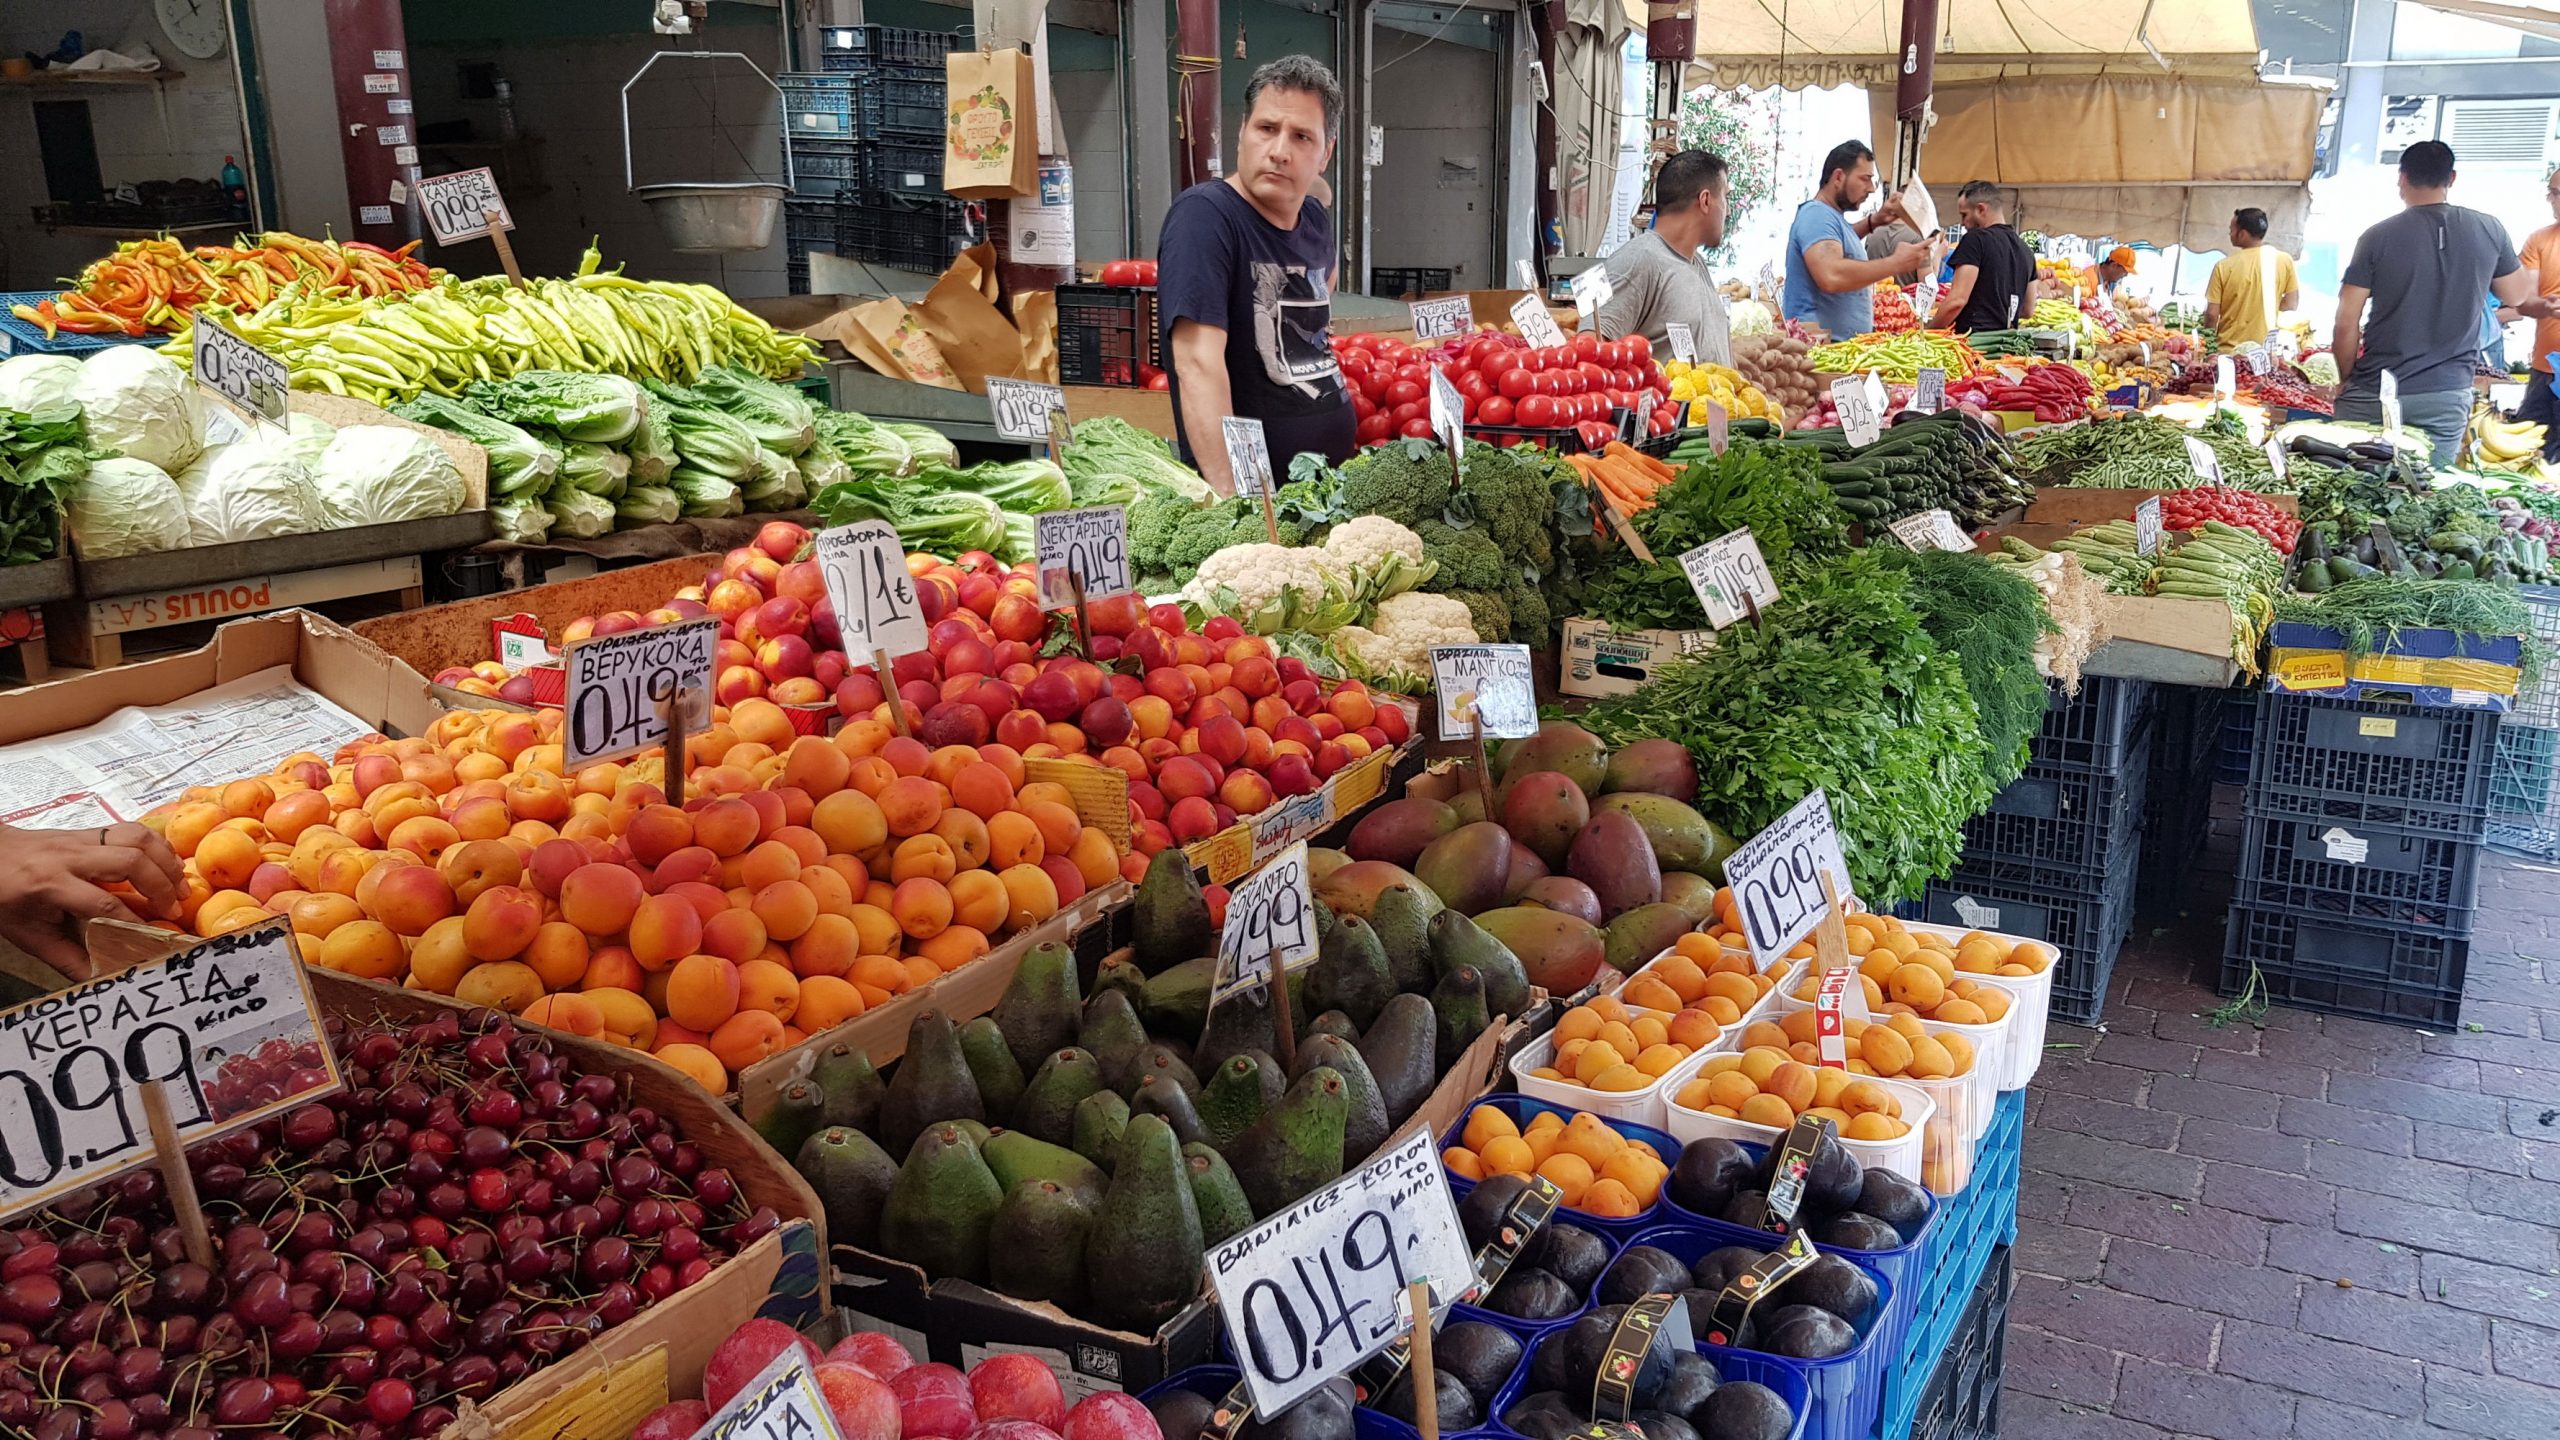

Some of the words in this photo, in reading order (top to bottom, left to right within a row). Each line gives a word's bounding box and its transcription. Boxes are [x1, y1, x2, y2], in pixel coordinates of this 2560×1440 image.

[424, 178, 491, 202] ΚΑΥΤΕΡΕΣ
[1414, 301, 1467, 317] ΦΛΩΡΙΝΗΣ
[208, 331, 275, 378] ΛΑΧΑΝΟ
[1000, 386, 1059, 405] ΜΑΡΟΥΛΙ
[1040, 519, 1122, 546] ΝΕΚΤΑΡΙΝΙΑ
[166, 581, 272, 621] POULIS
[581, 635, 704, 684] ΒΕΡΥΚΟΚΑ
[1454, 659, 1517, 678] ΜΑΝΓΚΟ
[1809, 814, 1825, 829] ΤΟ
[22, 964, 232, 1060] ΚΕΡΑΣΙΑ
[195, 997, 268, 1032] ΚΙΛΟ
[1399, 1161, 1428, 1180] ΤΟ
[1390, 1172, 1435, 1212] ΚΙΛΟ
